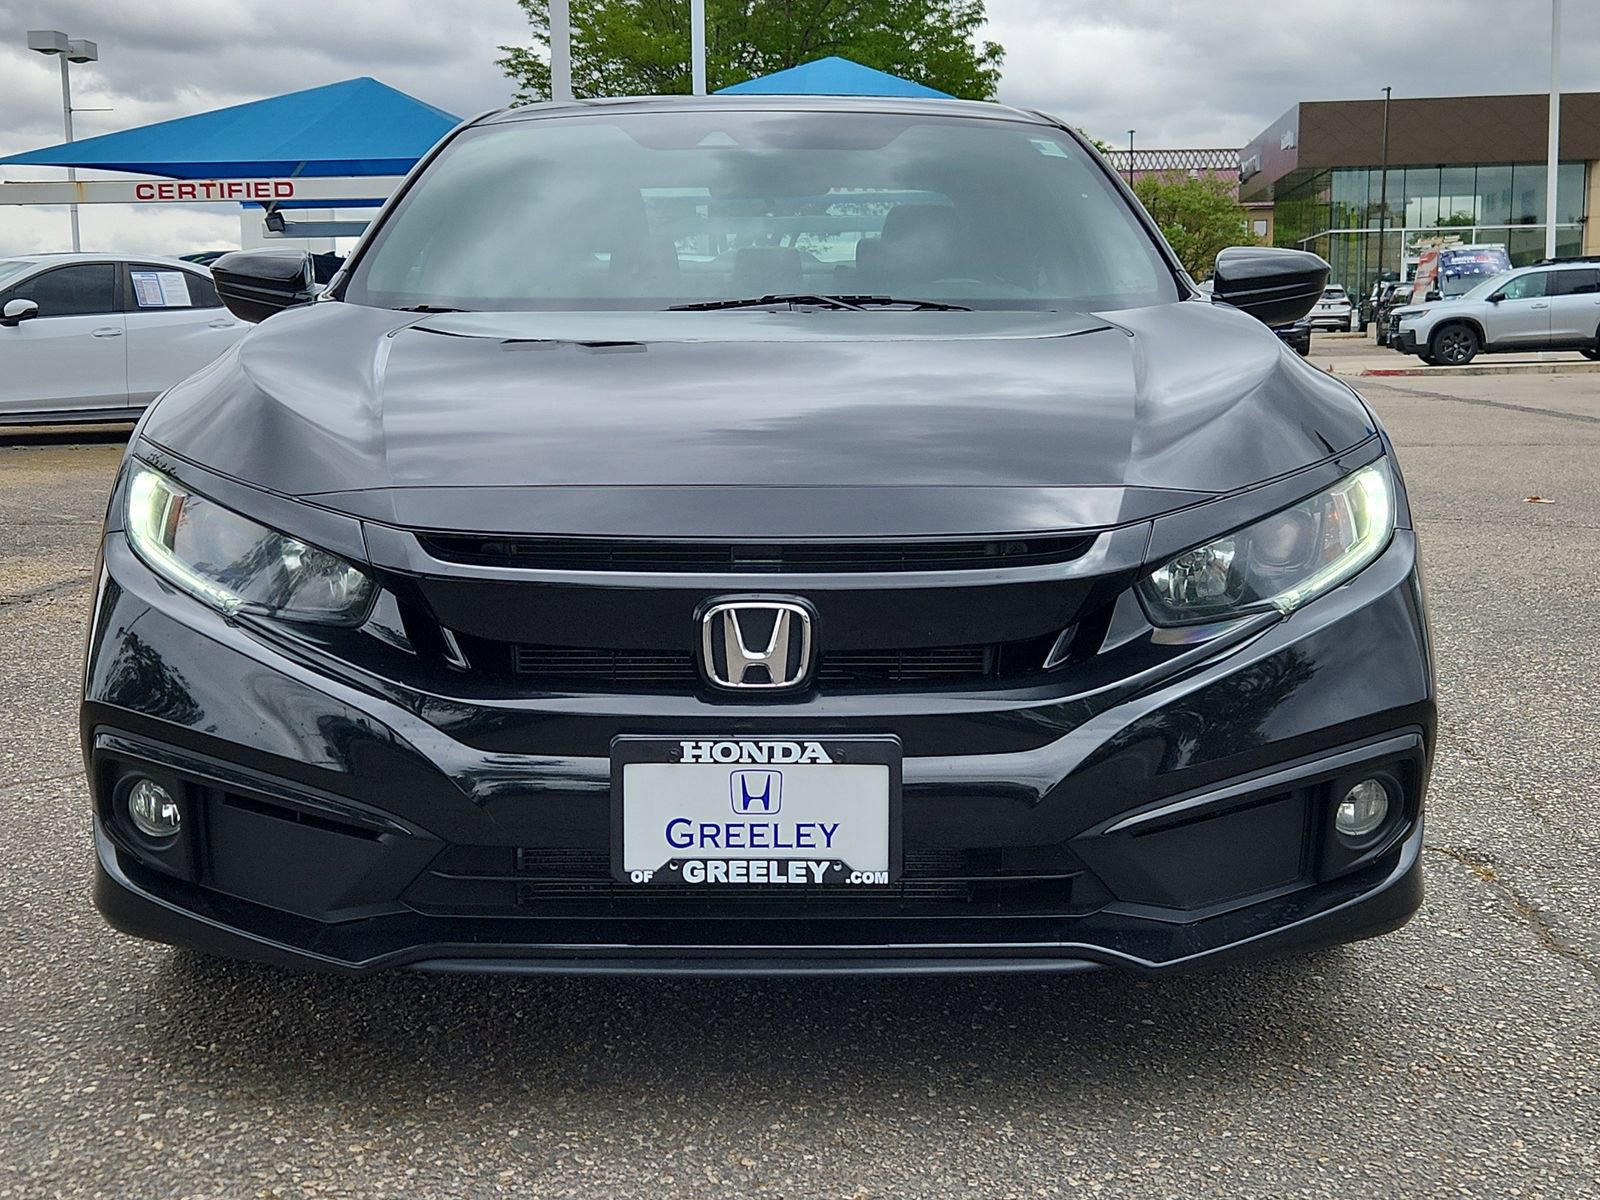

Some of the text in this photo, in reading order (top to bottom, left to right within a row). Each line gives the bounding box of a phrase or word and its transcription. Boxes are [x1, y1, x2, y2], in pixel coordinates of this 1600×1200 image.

[135, 181, 294, 201] CERTIFIED
[679, 741, 833, 764] HONDA
[630, 860, 889, 885] OF GREELEY .COM
